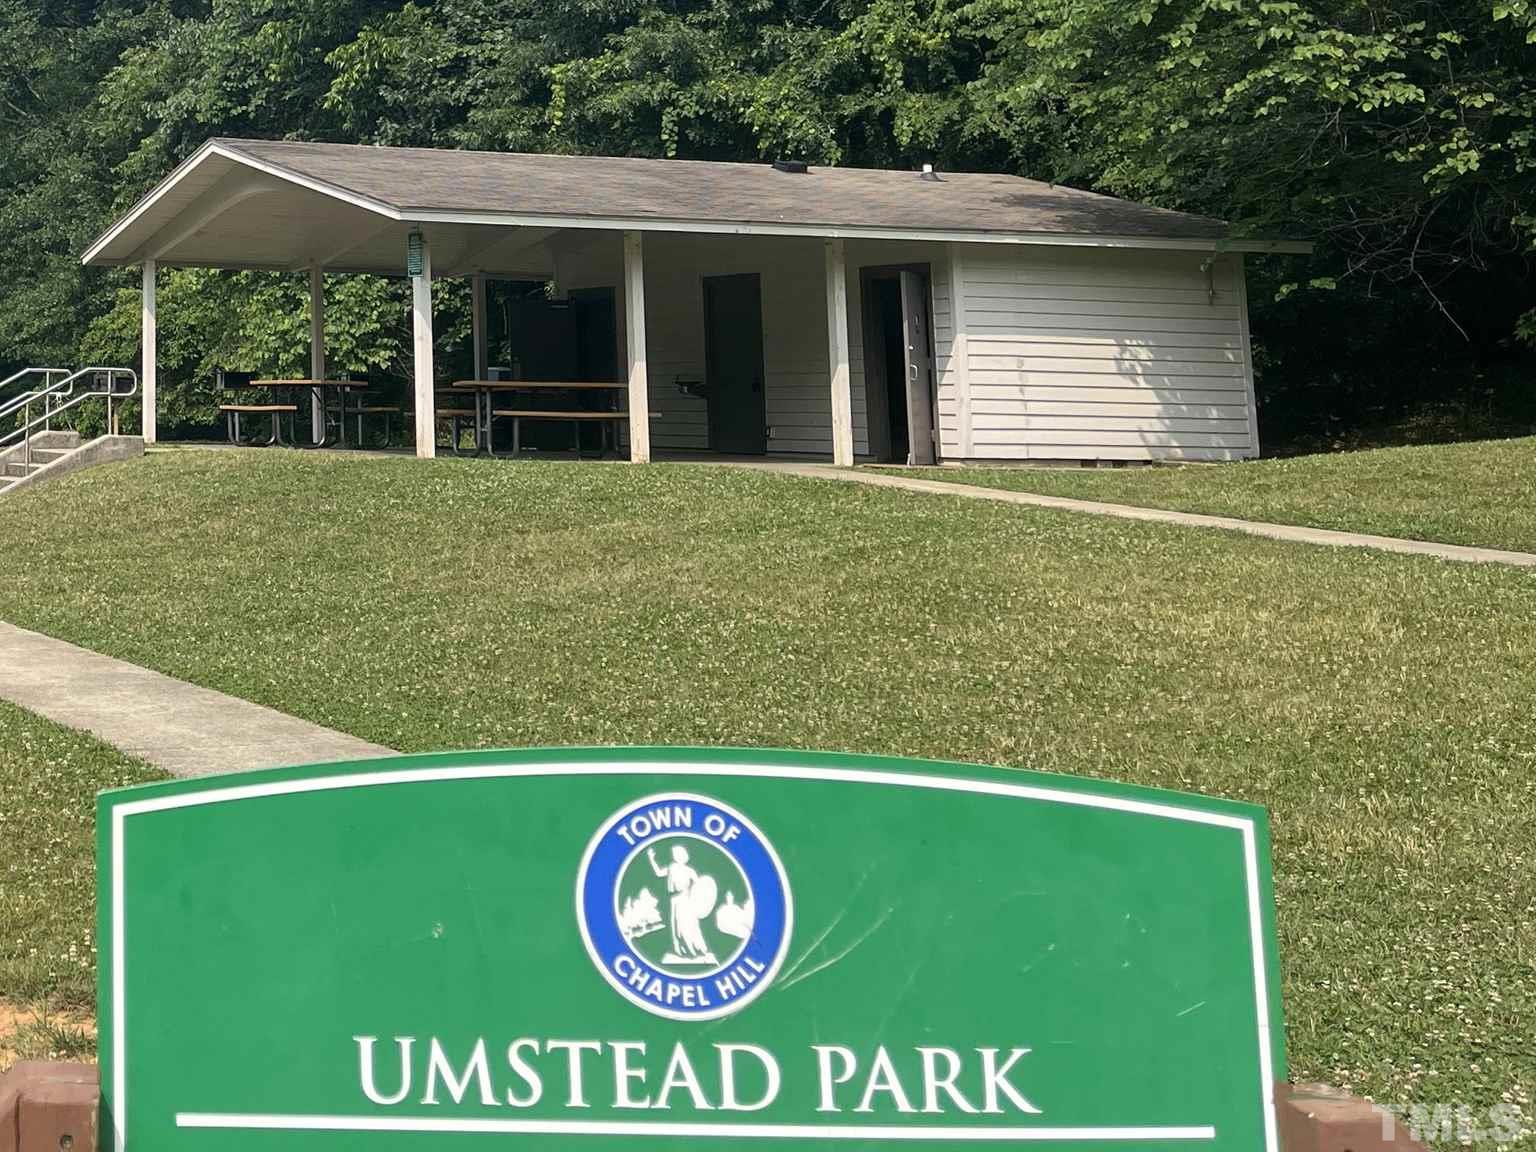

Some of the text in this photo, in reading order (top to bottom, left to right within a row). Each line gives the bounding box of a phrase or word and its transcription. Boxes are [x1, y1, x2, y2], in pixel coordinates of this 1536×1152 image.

[616, 806, 741, 845] TOWN OF
[614, 955, 766, 1008] CHAPEL HILL
[352, 1035, 1045, 1114] UMSTEAD PARK
